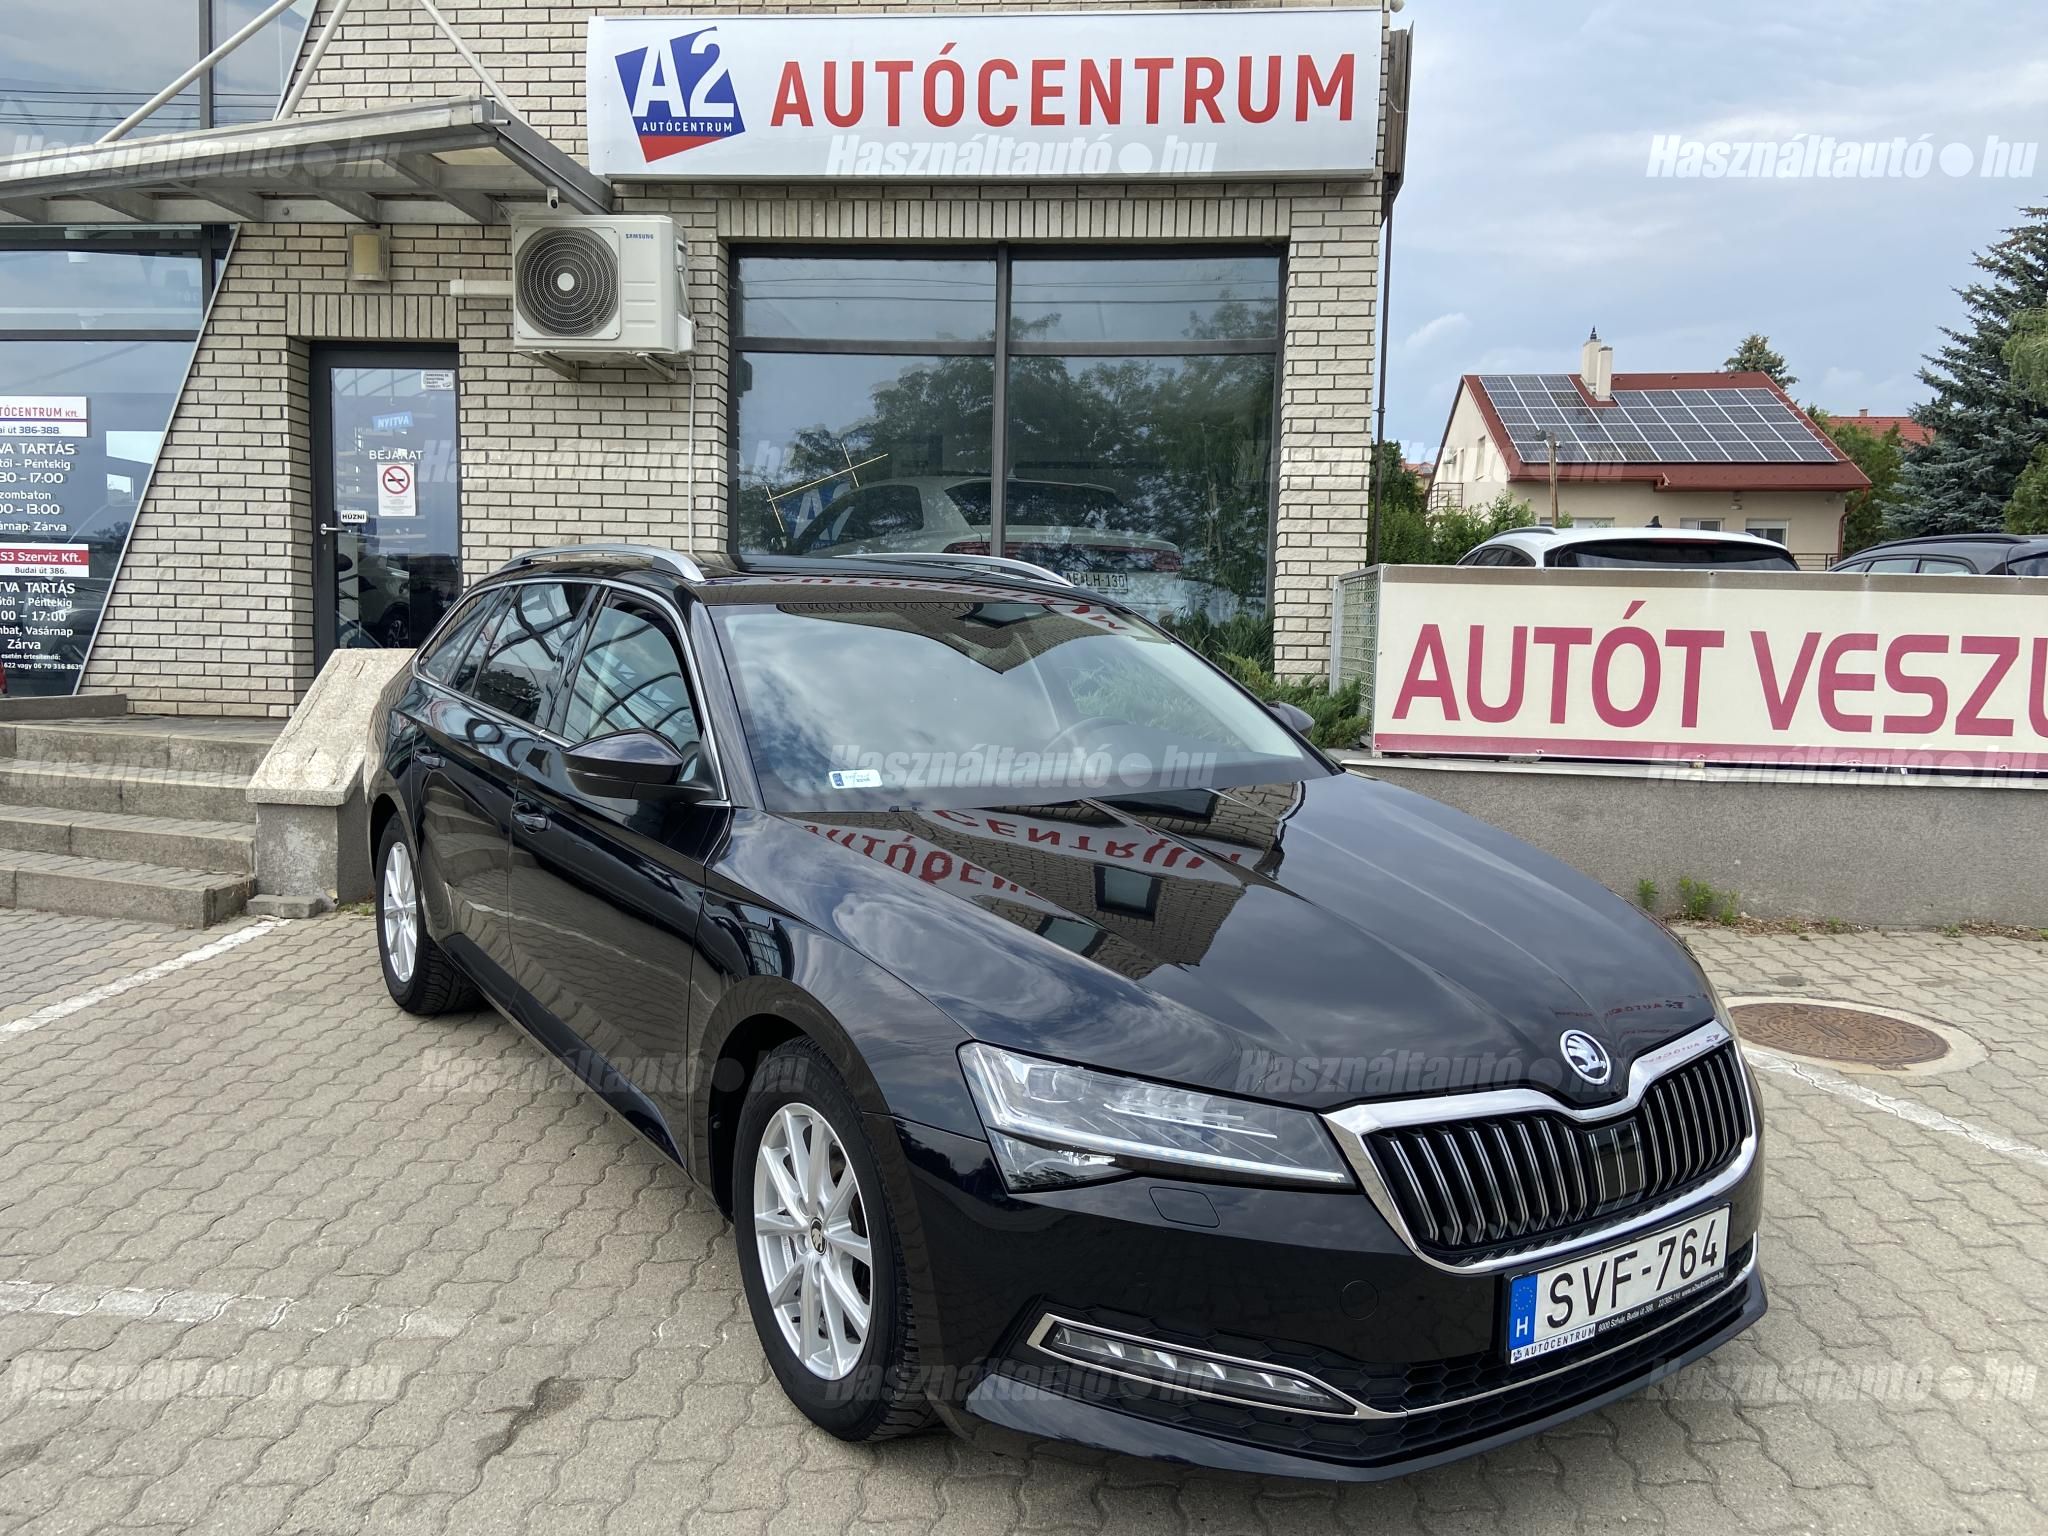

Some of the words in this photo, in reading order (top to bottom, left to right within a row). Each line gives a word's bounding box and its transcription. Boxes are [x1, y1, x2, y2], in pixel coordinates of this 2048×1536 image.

[632, 30, 735, 118] A2
[771, 42, 1355, 128] AUTÓCENTRUM
[642, 119, 732, 133] AUTÓCENTRUM
[19, 440, 75, 455] TARTÁS
[24, 458, 71, 471] Péntekig
[29, 472, 64, 484] 17:00
[26, 503, 61, 515] 13:00
[33, 521, 68, 532] Zárva
[17, 551, 59, 562] Szerviz
[61, 552, 82, 563] Kft.
[14, 566, 37, 574] Budai
[50, 567, 68, 575] 386.
[25, 579, 76, 594] TARTÁS
[27, 597, 73, 609] Péntekig
[31, 611, 67, 622] 17:00
[25, 626, 74, 638] Vasárnap
[7, 639, 41, 650] Zárva
[1391, 600, 1725, 728] AUTÓT
[1546, 1219, 1717, 1329] SVF-764
[1516, 1316, 1528, 1337] H
[1524, 1325, 1595, 1357] AUTÓCENTRUM
